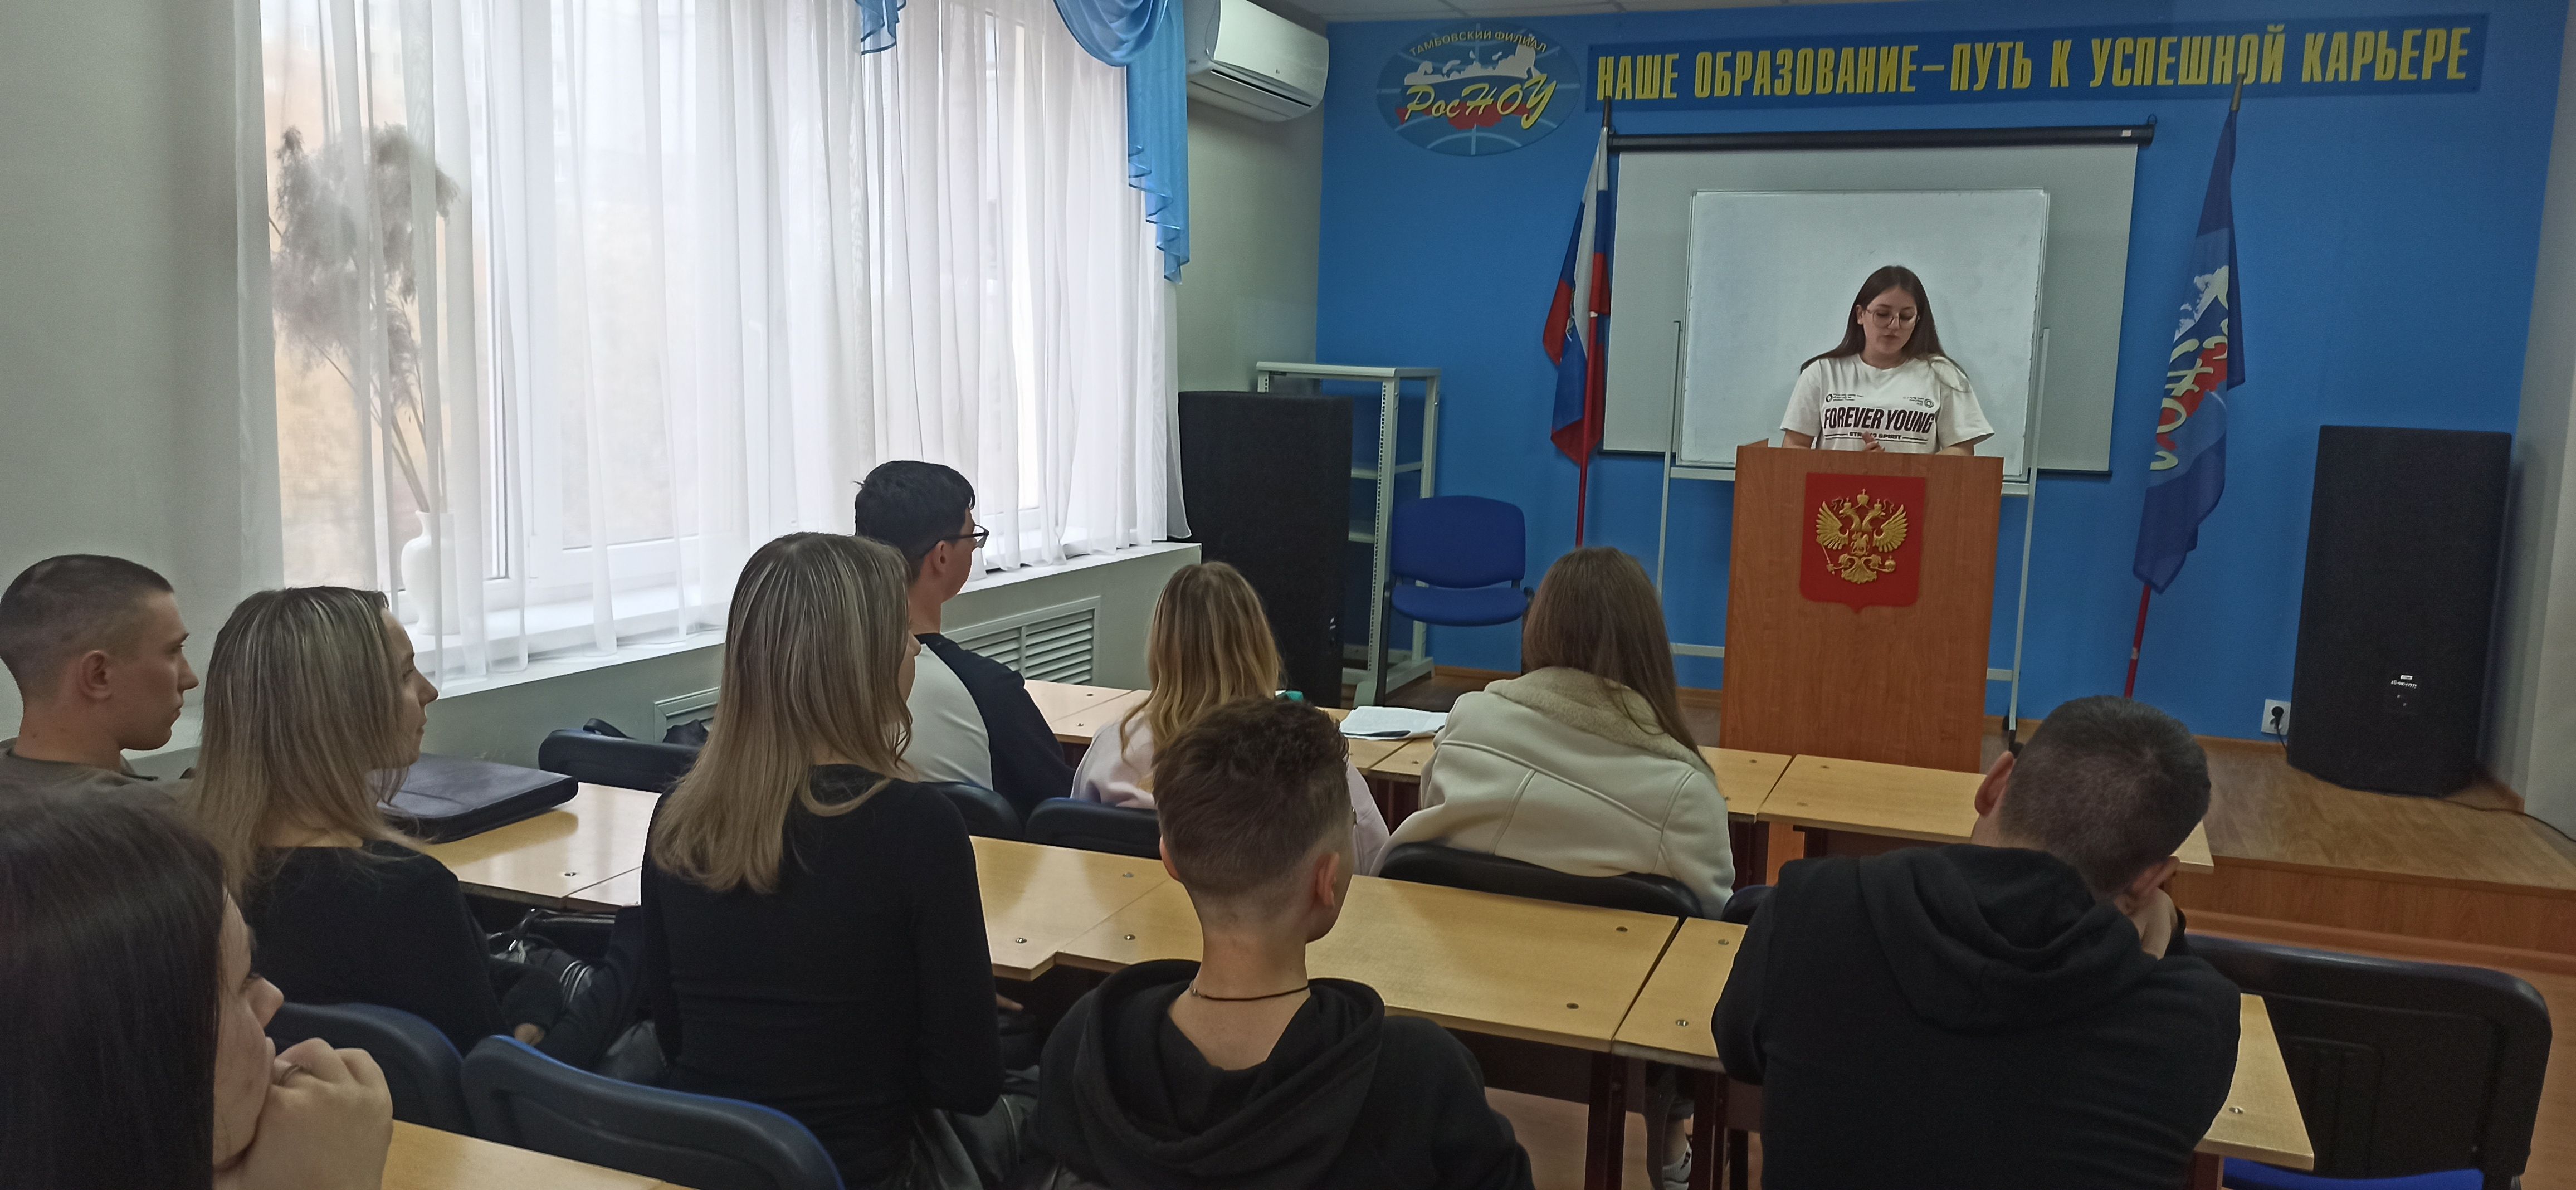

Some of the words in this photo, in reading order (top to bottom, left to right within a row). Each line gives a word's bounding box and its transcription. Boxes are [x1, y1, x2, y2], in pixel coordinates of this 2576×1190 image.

[1495, 31, 1547, 53] ФИЛИАЛ
[1597, 53, 1679, 101] НАШЕ
[2050, 40, 2072, 87] К
[2090, 24, 2285, 88] УСПЕШНОЙ
[2301, 27, 2470, 82] КАРЬЕРЕ
[1404, 74, 1556, 129] РосНОУ
[1824, 407, 1885, 429] FOREVER
[1885, 409, 1935, 433] YOUNG
